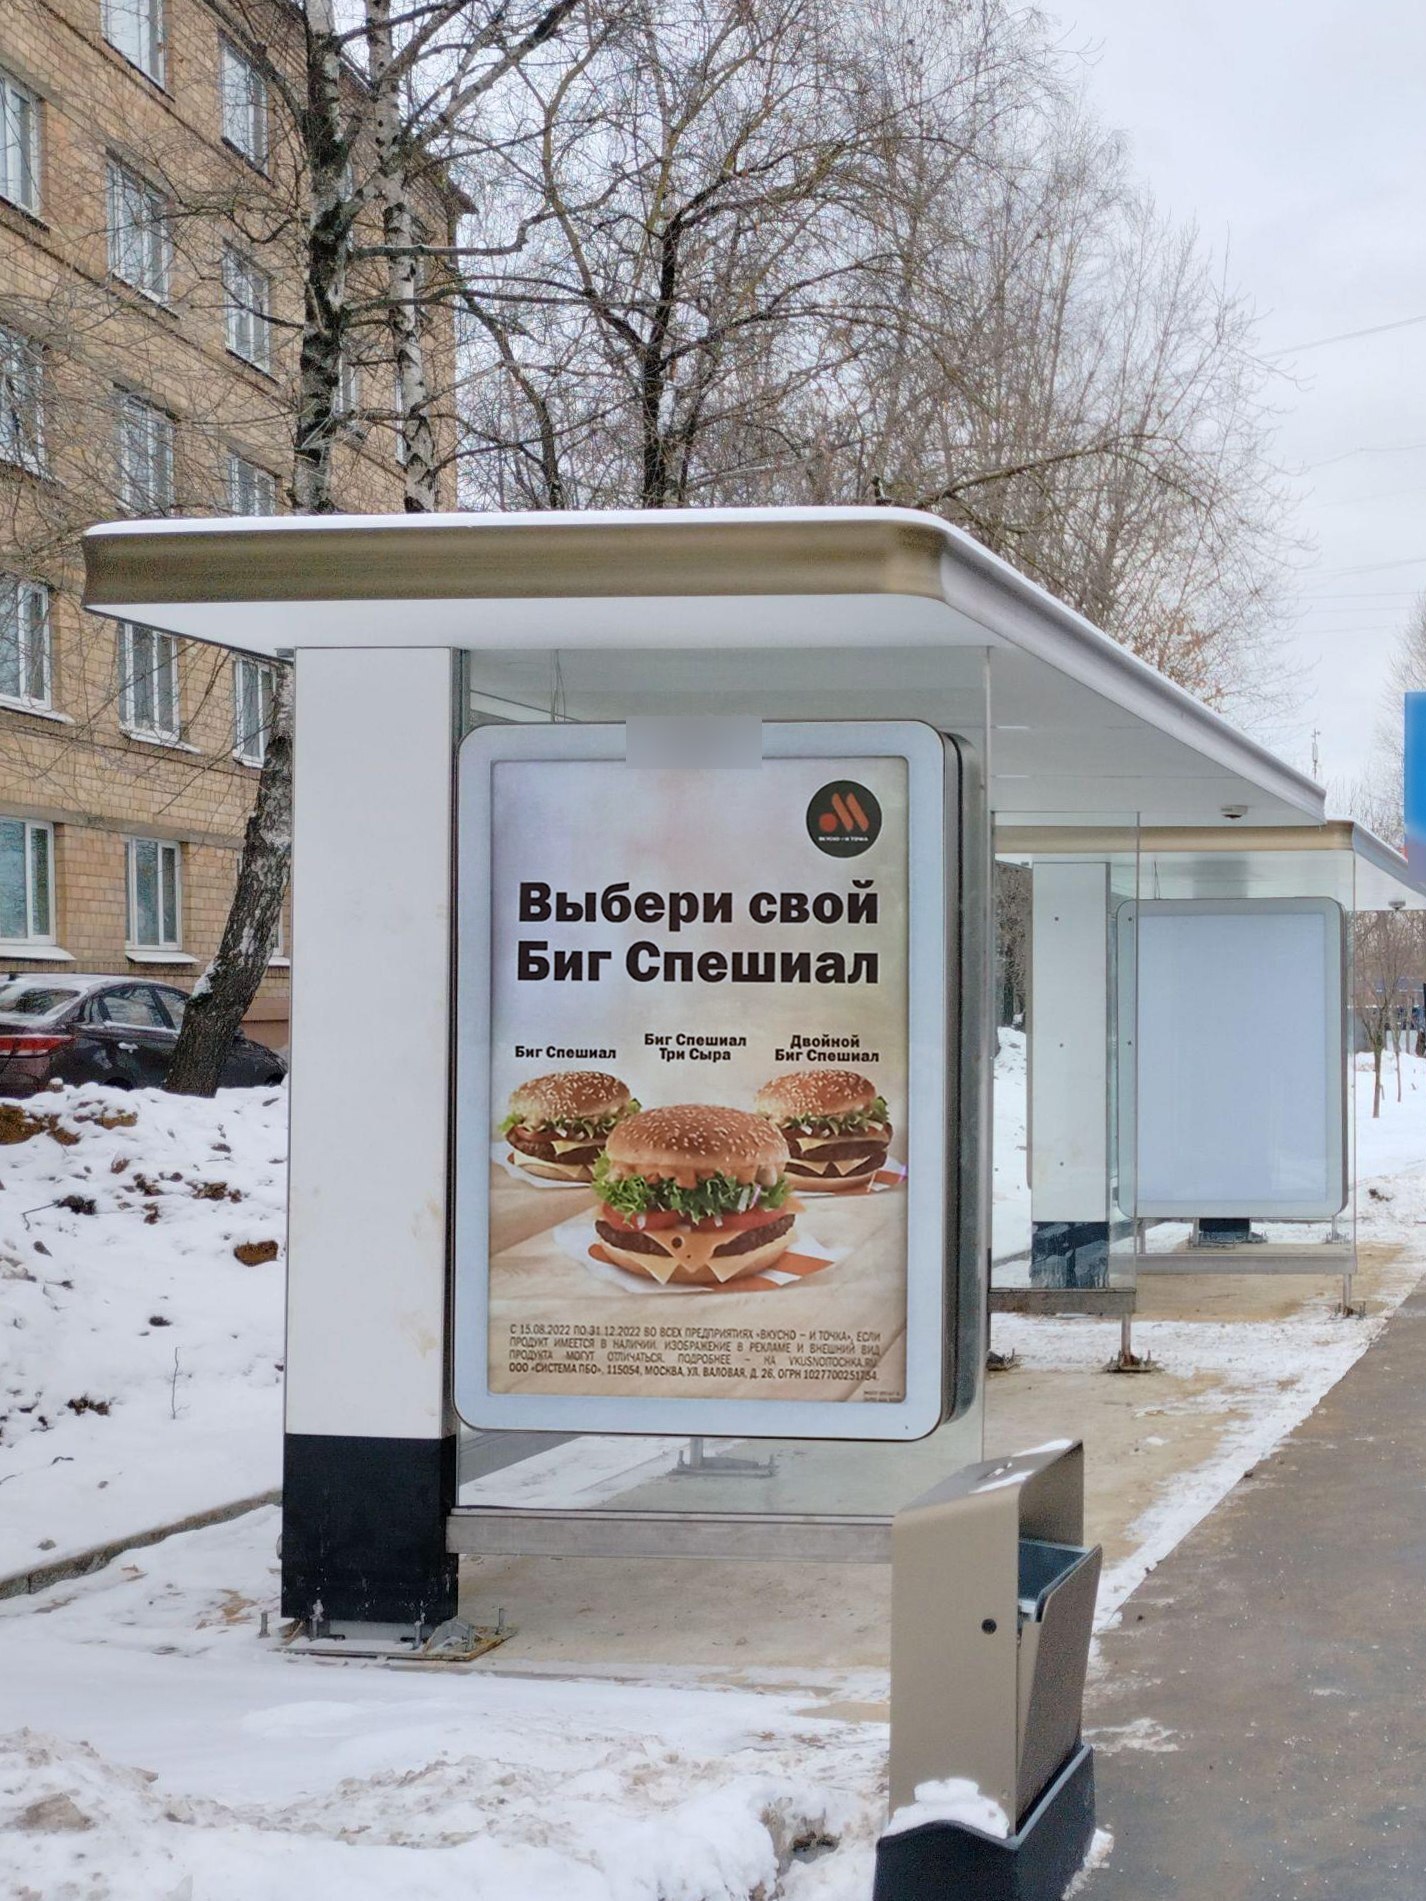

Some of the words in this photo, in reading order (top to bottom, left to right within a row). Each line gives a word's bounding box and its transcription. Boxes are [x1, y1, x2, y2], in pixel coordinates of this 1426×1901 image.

[518, 881, 733, 931] Выбери
[749, 879, 879, 924] свой
[517, 941, 612, 981] Биг
[625, 940, 879, 984] Спешиал
[644, 1033, 672, 1046] Биг
[675, 1033, 747, 1047] Спешиал
[790, 1033, 860, 1050] Двойной
[515, 1045, 543, 1058] Биг
[545, 1046, 617, 1060] Спешиал
[659, 1047, 685, 1062] Три
[689, 1048, 732, 1063] Сыра
[775, 1049, 804, 1062] Биг
[806, 1049, 880, 1063] Спешиал
[520, 1324, 571, 1336] 15.08.2022
[589, 1325, 641, 1337] 31.12.2022
[659, 1327, 682, 1338] ВСЕХ
[684, 1327, 754, 1340] ПРЕДПРИЯТИЯХ
[856, 1331, 881, 1342] ЕСЛИ
[509, 1337, 549, 1348] ПРОДУКТ
[553, 1337, 596, 1348] ИМЕЕТСЯ
[664, 1340, 731, 1352] ИЗОБРАЖЕНИЕ
[749, 1342, 791, 1353] РЕКЛАМЕ
[809, 1342, 856, 1354] ВНЕШНИЙ
[861, 1345, 881, 1356] ВИД
[509, 1349, 553, 1361] ПРОДУКТА
[566, 1350, 596, 1361] МОГУТ
[677, 1353, 731, 1365] ПОДРОБНЕЕ
[509, 1362, 529, 1373] ООО
[777, 1369, 801, 1380] ОГРН
